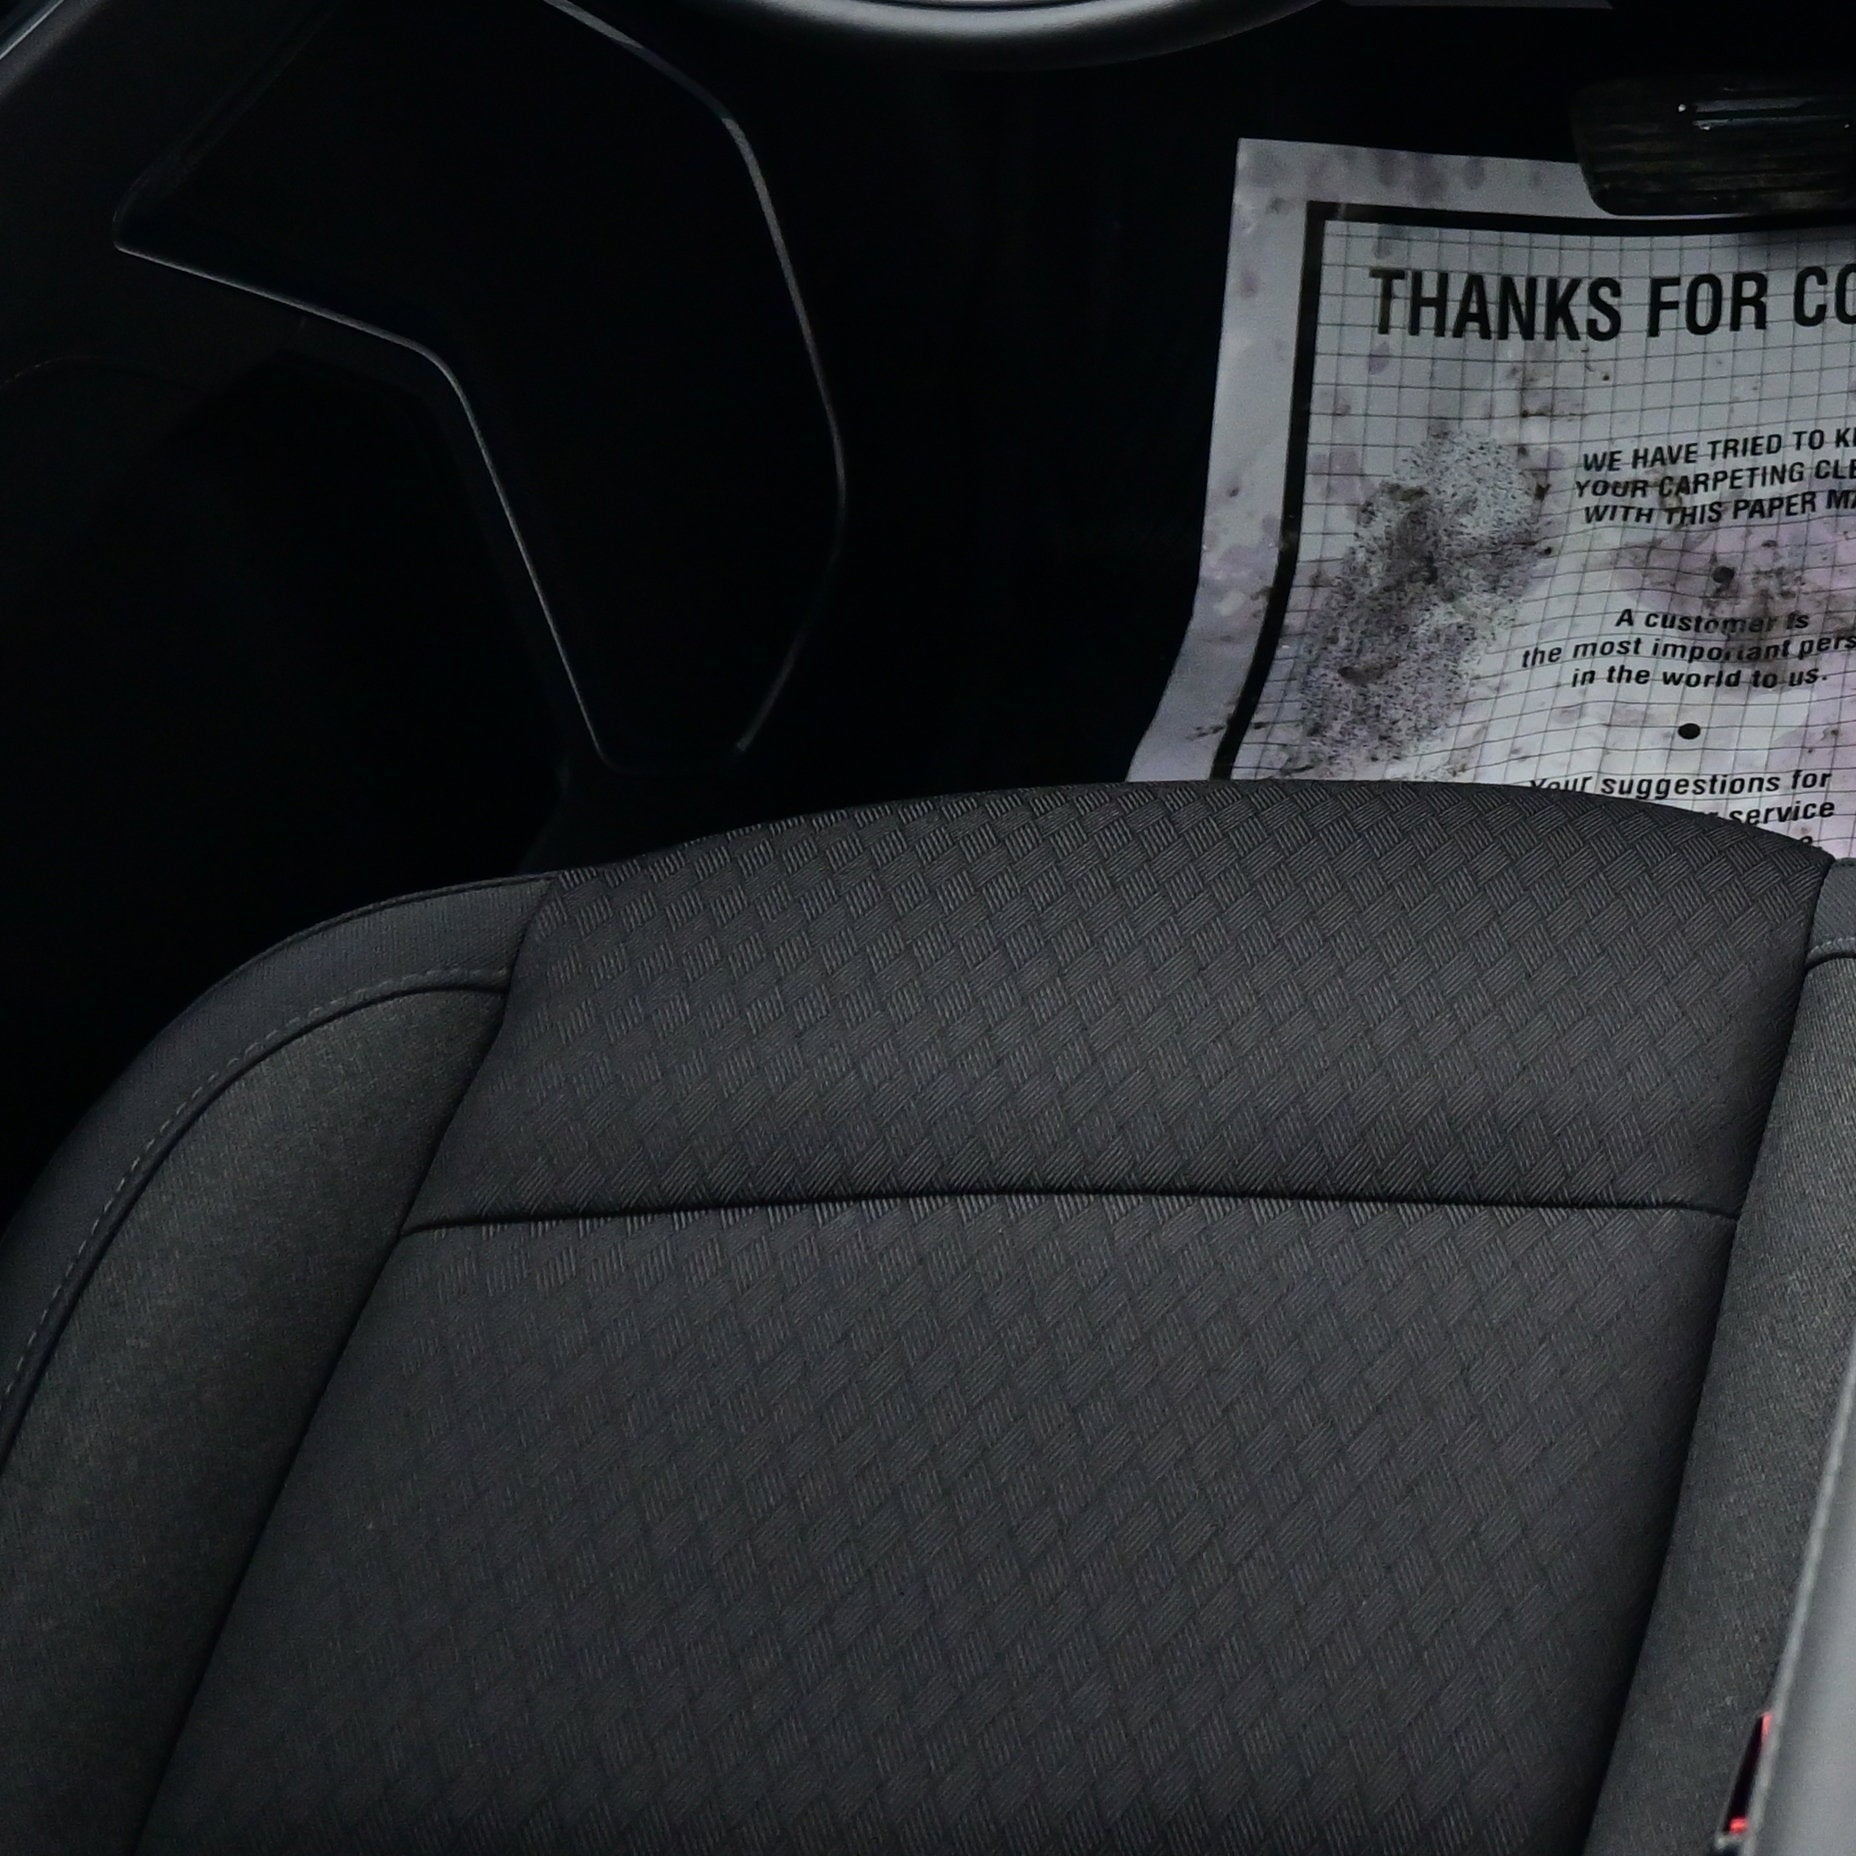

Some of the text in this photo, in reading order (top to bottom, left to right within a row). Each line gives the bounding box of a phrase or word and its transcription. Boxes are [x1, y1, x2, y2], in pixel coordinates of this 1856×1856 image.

[1369, 266, 1622, 341] THANKS
[1648, 270, 1768, 339] FOR
[1584, 450, 1622, 472] WE
[1632, 443, 1698, 469] HAVE
[1707, 433, 1782, 461] TRIED
[1792, 429, 1824, 452] TO
[1576, 479, 1649, 498] YOUR
[1659, 461, 1805, 496] CARPETING
[1585, 505, 1653, 524] WITH
[1666, 501, 1722, 525] THIS
[1733, 491, 1816, 520] PAPER
[1616, 609, 1809, 634] A customer is
[1521, 645, 1561, 669] the
[1573, 637, 1642, 658] most
[1572, 665, 1827, 688] in the world to us.
[1601, 772, 1780, 800] suggestions
[1792, 769, 1832, 789] for
[1729, 800, 1835, 825] service
